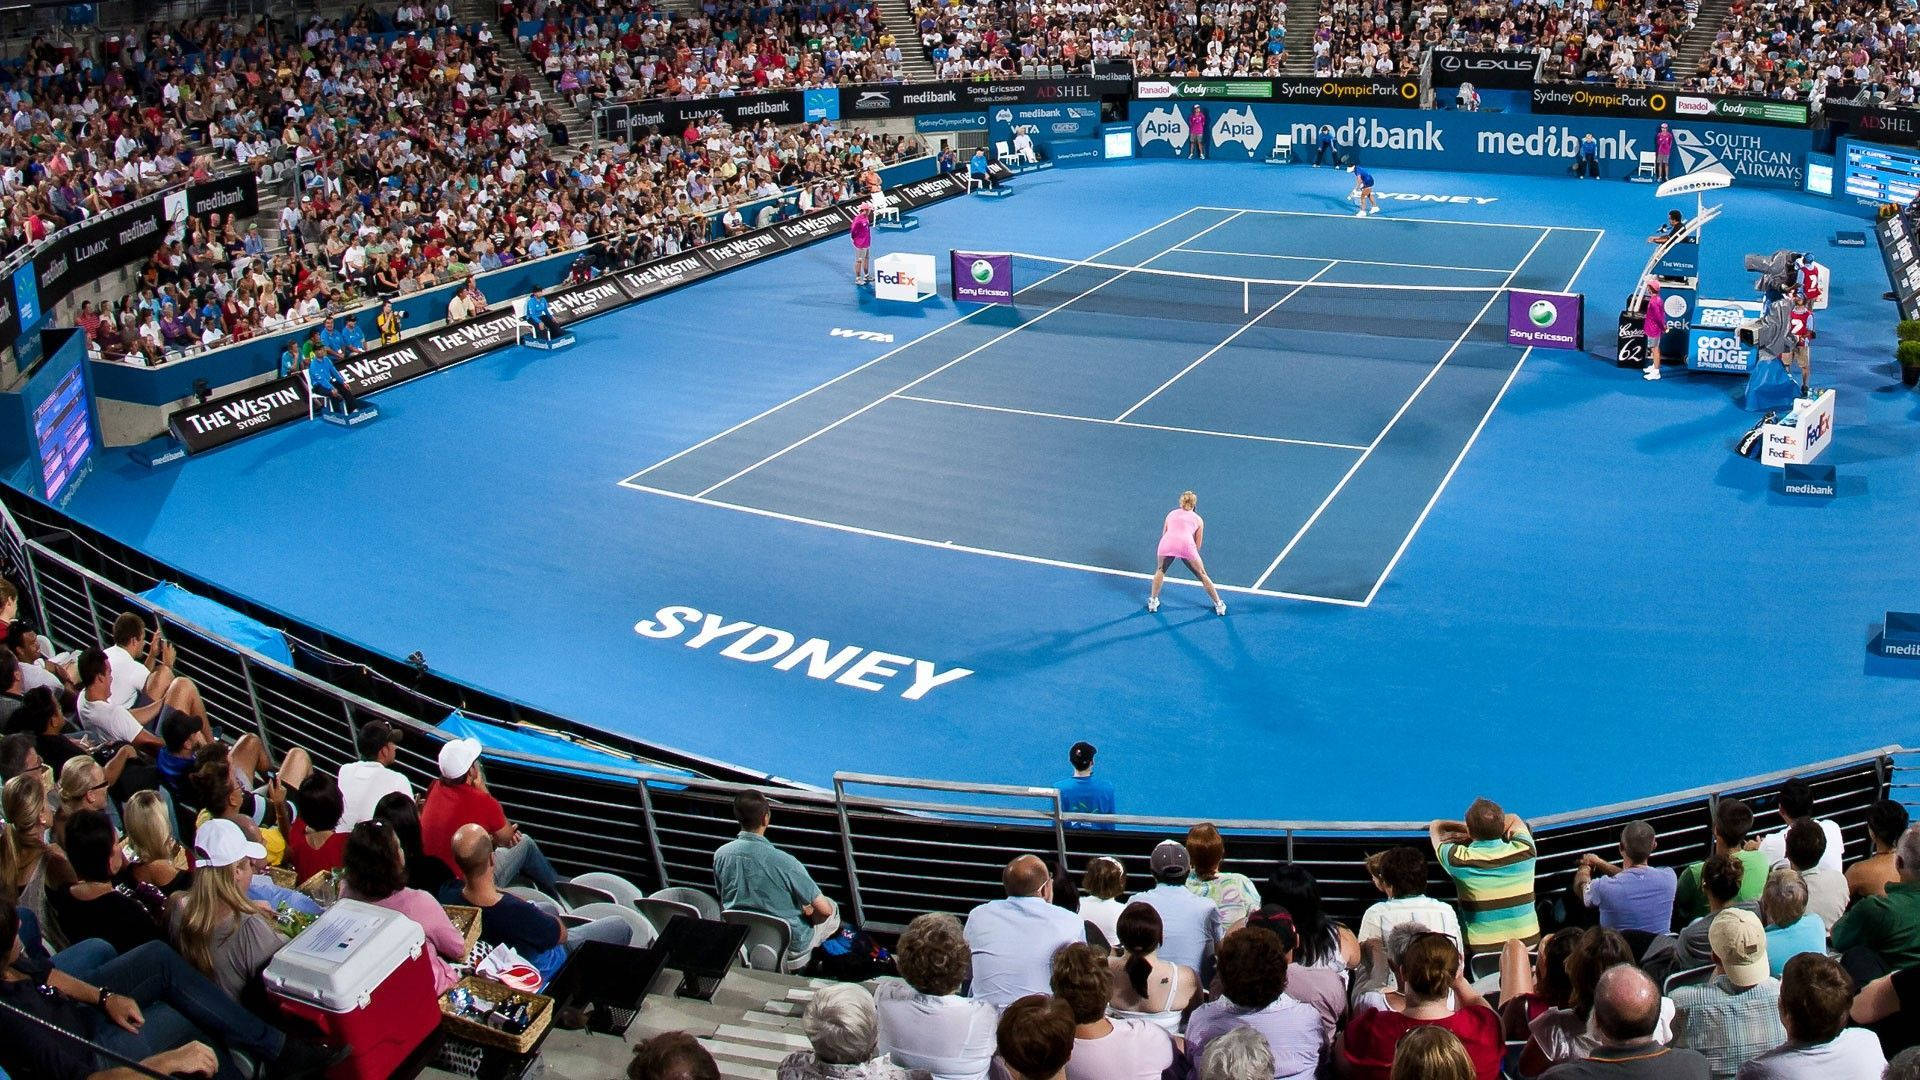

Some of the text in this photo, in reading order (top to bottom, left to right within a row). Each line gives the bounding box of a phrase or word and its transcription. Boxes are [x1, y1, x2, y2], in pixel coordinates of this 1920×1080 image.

[1465, 58, 1533, 70] LEXUS
[1095, 72, 1132, 82] medibank
[904, 90, 956, 104] medibank
[967, 84, 1025, 96] Sony Ericsson
[1036, 85, 1090, 98] ADSHEL
[1140, 86, 1169, 94] Panadol
[738, 100, 790, 116] medibank
[1020, 108, 1060, 118] medibank
[1678, 101, 1708, 110] Panadol
[616, 112, 664, 129] medibank
[680, 109, 720, 120] LUMIX
[1145, 120, 1181, 136] Apia
[1220, 121, 1254, 138] Apia
[1860, 116, 1913, 132] ADSHEL
[1478, 126, 1638, 161] medibnk
[1704, 130, 1761, 149] SOUTH
[1721, 145, 1791, 164] AFRICAN
[1734, 160, 1802, 180] AIRWAYS
[902, 178, 953, 199] THE WESTIN
[196, 187, 244, 213] medibank
[1374, 192, 1498, 204] YDNEY
[120, 215, 158, 245] medibank
[780, 212, 842, 238] THE WESTIN
[75, 239, 110, 262] LUMIX
[706, 233, 776, 261] THE WESTIN
[624, 257, 701, 288] THE WESTIN
[877, 270, 918, 286] FedEx
[548, 284, 618, 314] HE WESTIN
[958, 287, 1008, 296] Sony Ericsson
[572, 302, 598, 315] SYDNEY
[1666, 319, 1690, 330] eek
[428, 333, 468, 352] THE
[472, 335, 501, 349] SYDNEY
[830, 328, 894, 343] WTA
[1510, 329, 1573, 342] Sony Ericsson
[1618, 338, 1642, 362] 62
[1698, 349, 1750, 365] RIDGE
[346, 348, 418, 378] WESTIN
[1724, 363, 1747, 371] WATER
[360, 371, 392, 387] SYDNEY
[186, 411, 232, 434] THE
[223, 387, 300, 420] WESTIN
[236, 412, 272, 430] SYDNEY
[1806, 412, 1831, 450] FedEx
[1770, 434, 1796, 446] FedEx
[1768, 448, 1794, 460] FedEx
[1786, 484, 1833, 495] medibank
[634, 605, 975, 700] SYDNEY
